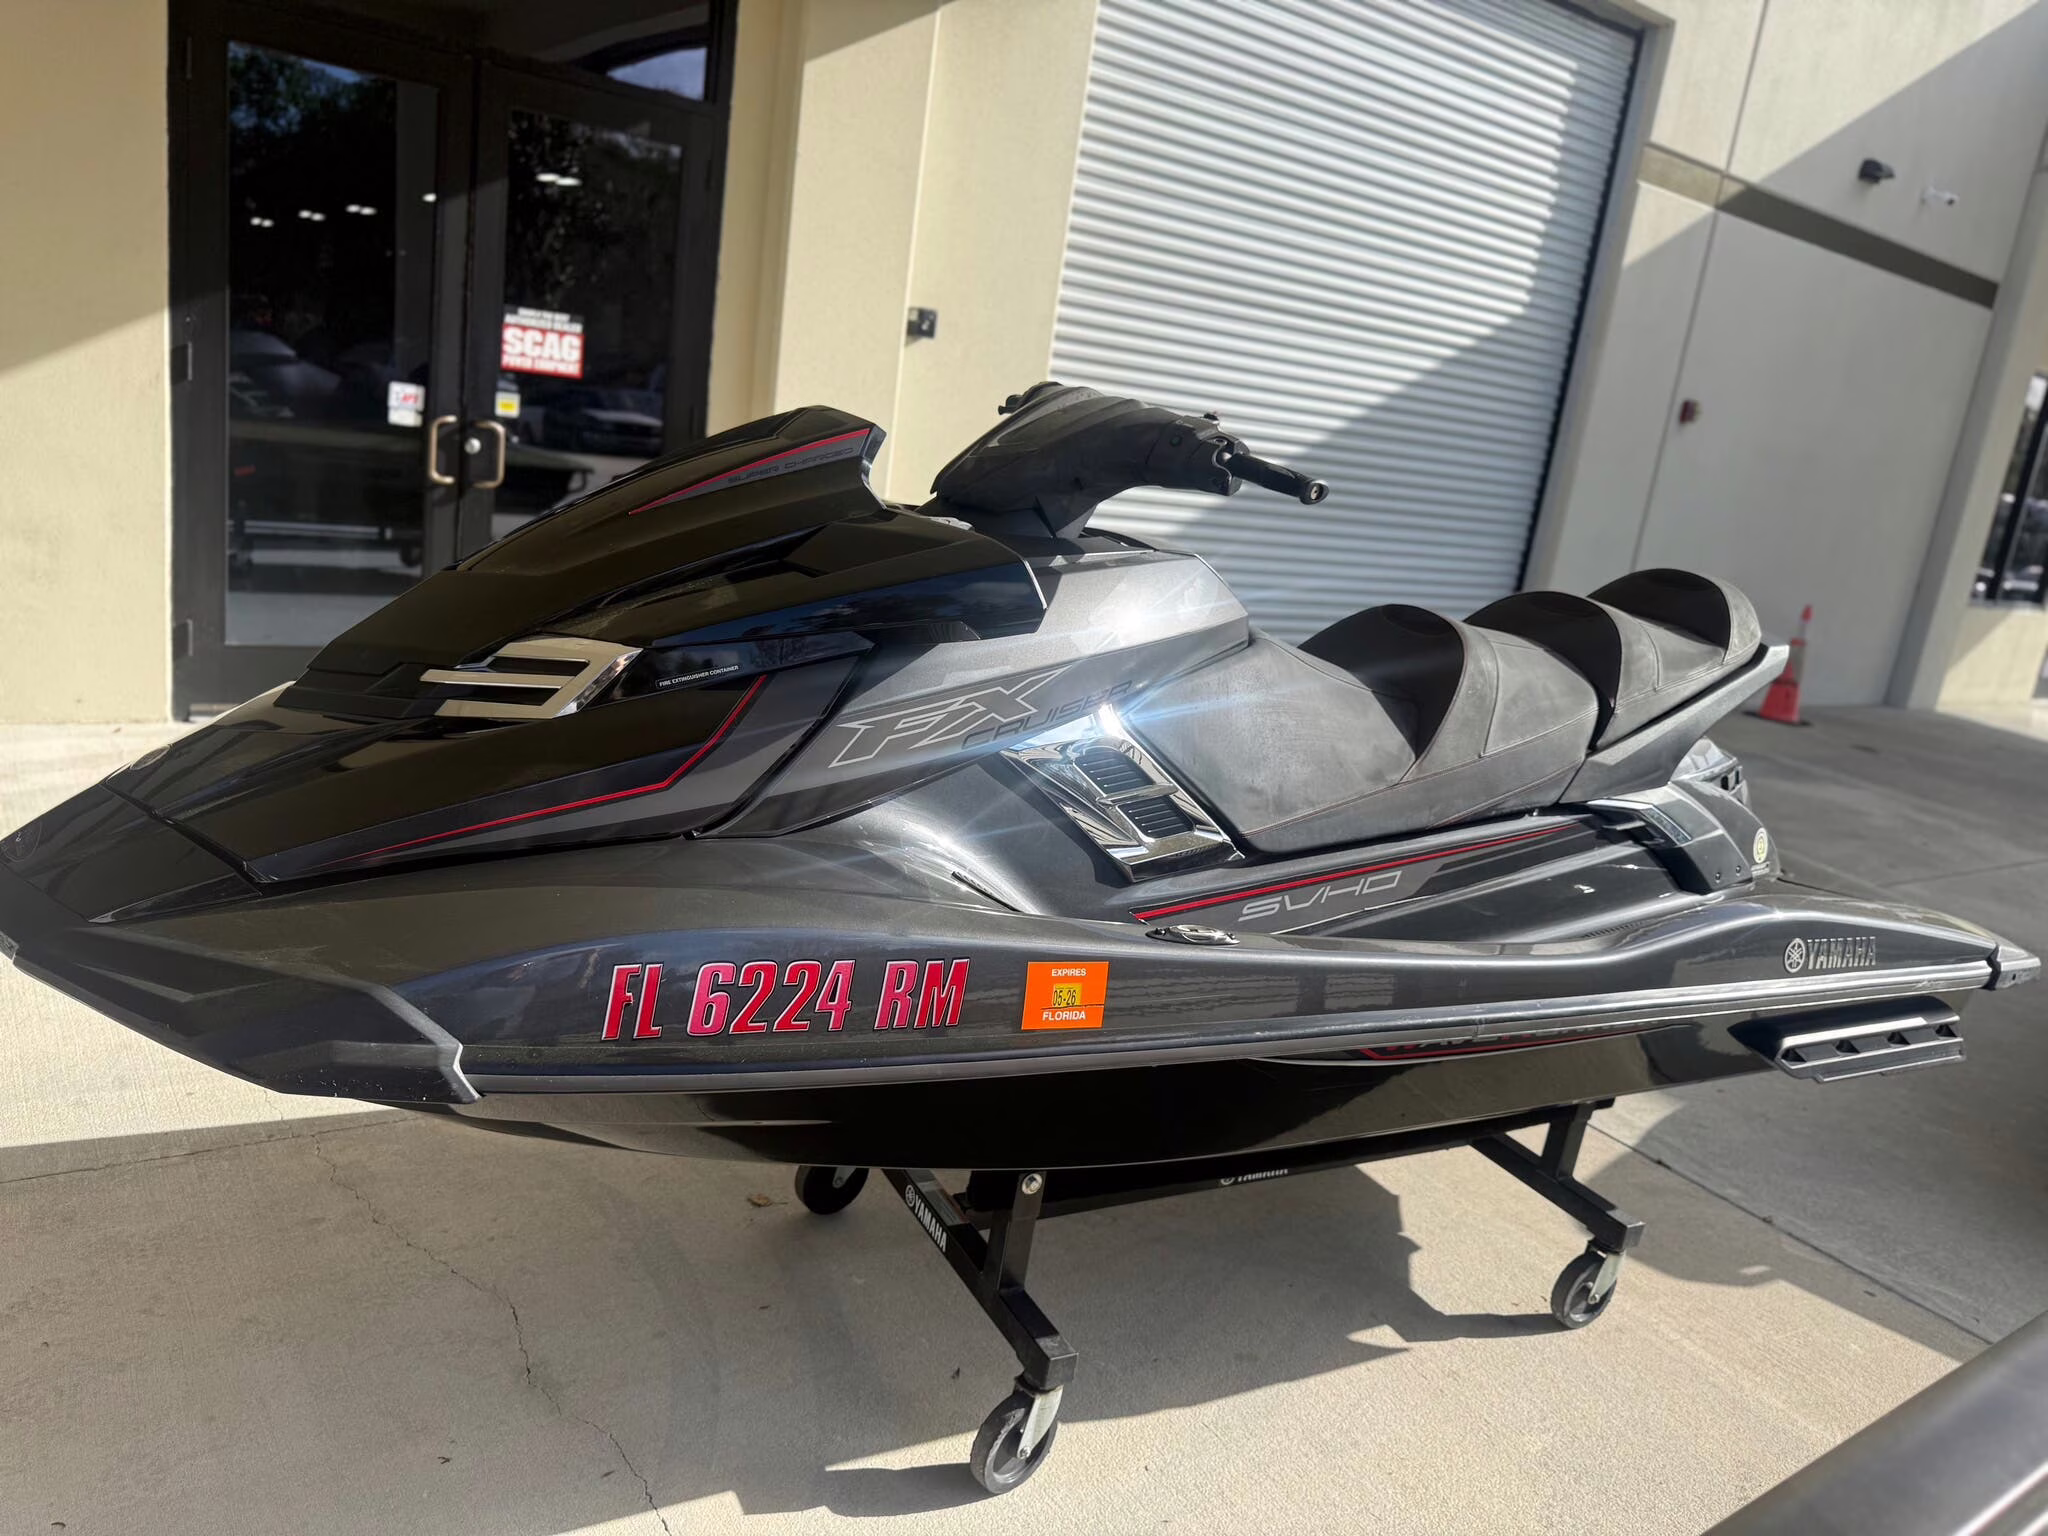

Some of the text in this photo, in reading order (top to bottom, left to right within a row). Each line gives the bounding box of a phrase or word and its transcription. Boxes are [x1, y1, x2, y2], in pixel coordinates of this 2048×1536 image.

[503, 327, 580, 362] SCAG
[672, 671, 709, 684] EXTINGUISHER
[709, 665, 739, 676] CONTAINER
[828, 665, 1072, 768] FX
[961, 680, 1132, 750] CRUISER
[1238, 870, 1402, 922] SVHO
[1807, 936, 1876, 970] YAMAHA
[1051, 968, 1087, 977] EXPIRES
[601, 958, 970, 1041] FL 6224 RM
[1053, 989, 1077, 1006] 05-26
[1042, 1010, 1086, 1021] FLORIDA
[914, 1194, 947, 1253] YAMAHA
